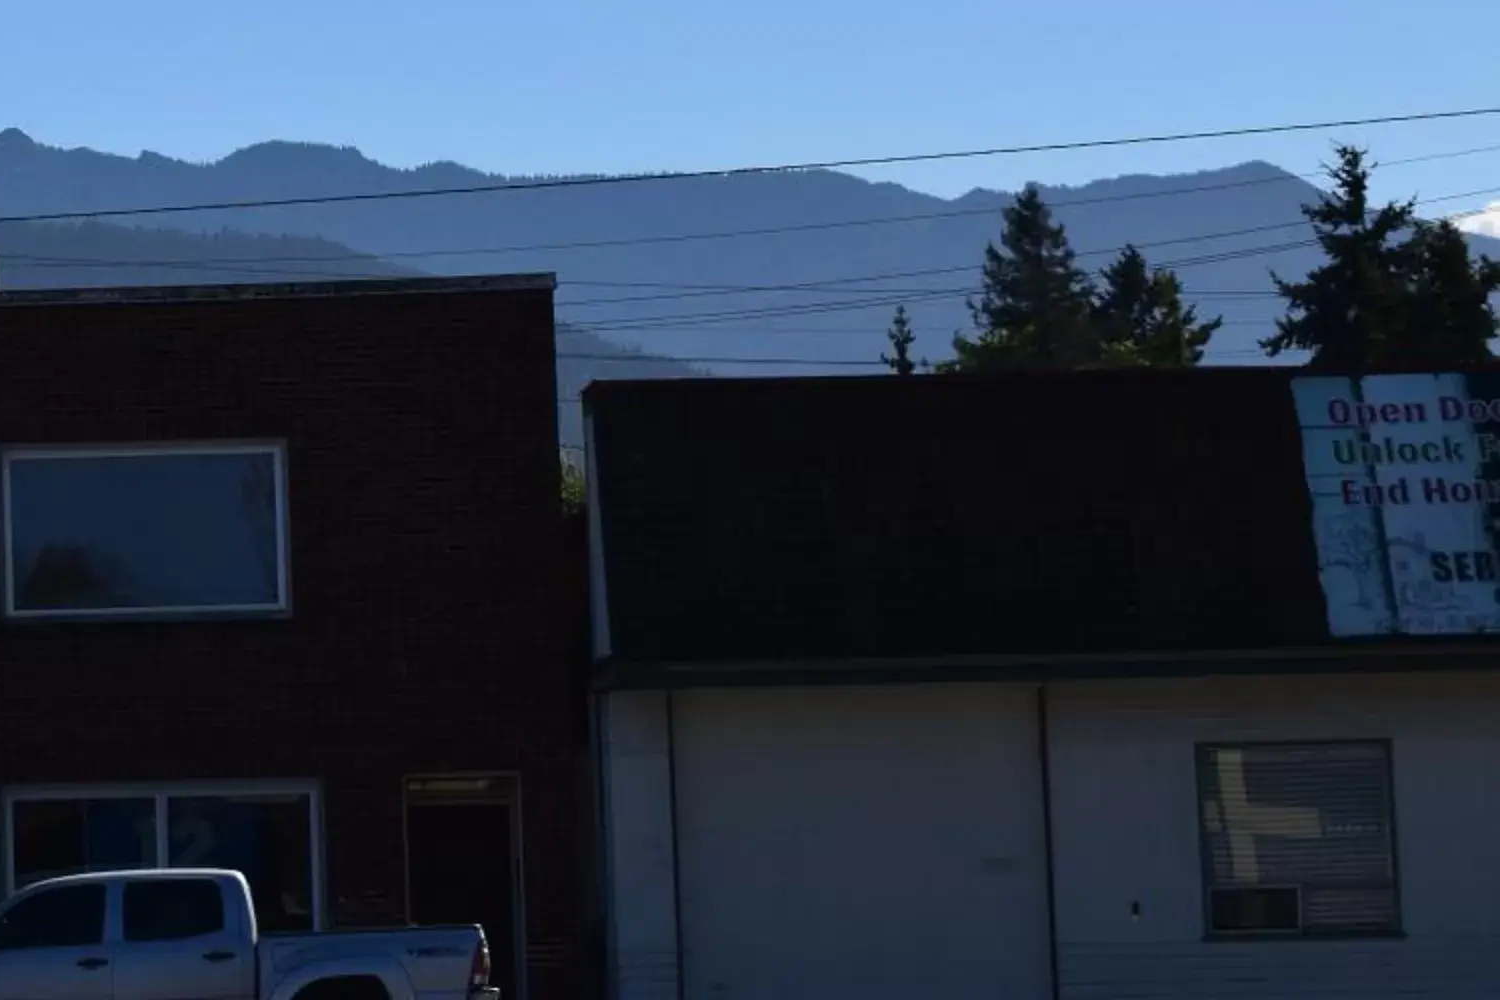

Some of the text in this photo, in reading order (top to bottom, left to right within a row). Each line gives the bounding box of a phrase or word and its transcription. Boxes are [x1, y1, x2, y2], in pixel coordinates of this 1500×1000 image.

[1328, 398, 1426, 427] Open
[1331, 436, 1466, 465] Unlock
[1341, 477, 1410, 505] End
[1430, 551, 1500, 582] SER
